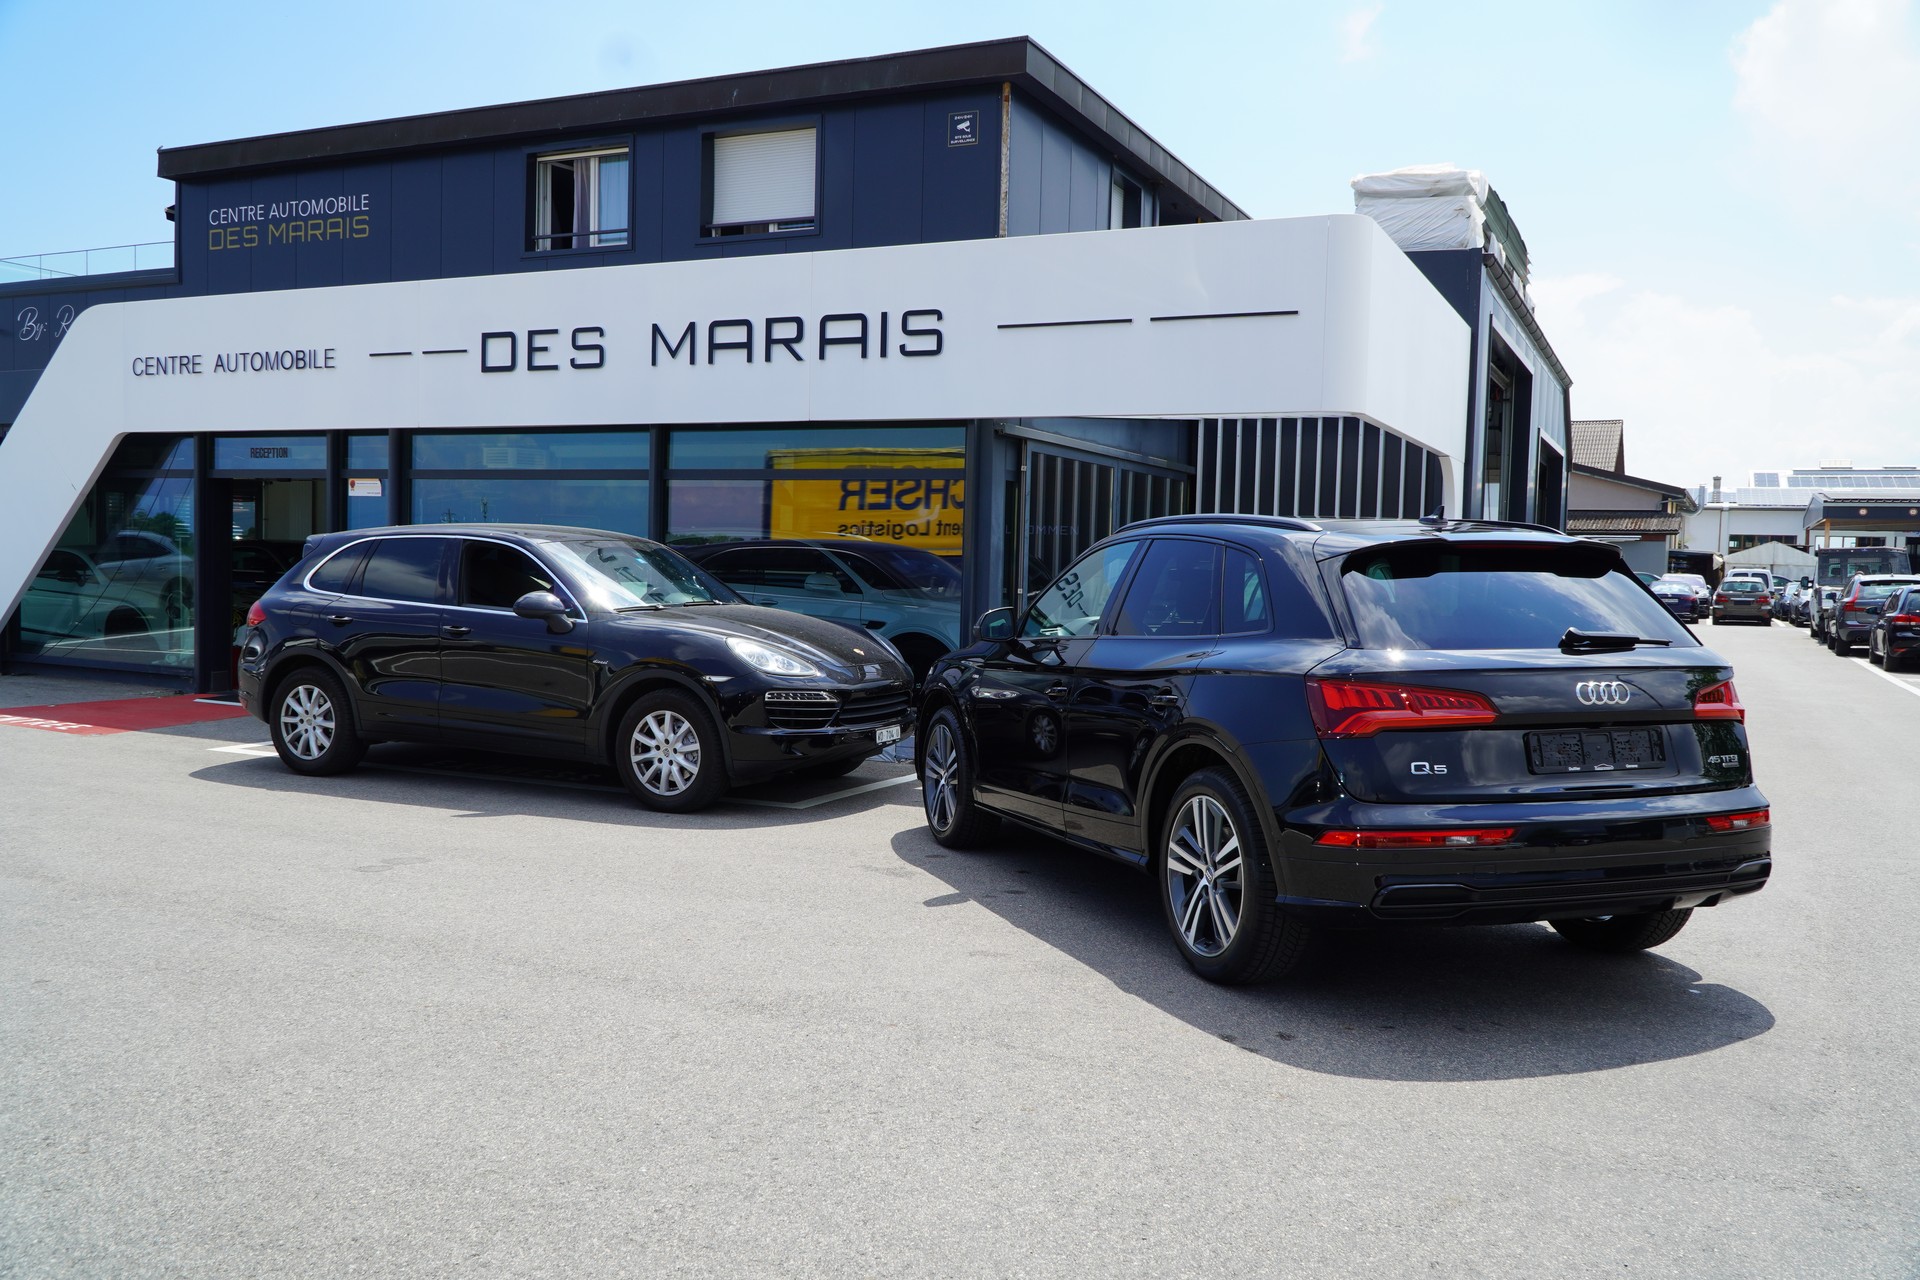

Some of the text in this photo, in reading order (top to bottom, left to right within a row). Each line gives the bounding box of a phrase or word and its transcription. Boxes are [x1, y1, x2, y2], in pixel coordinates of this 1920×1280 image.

[209, 194, 370, 226] CENTRE AUTOMOBILE
[209, 215, 370, 251] DES MARAIS
[131, 308, 944, 377] CENTRE AUTOMOBILE DES MARAIS
[250, 447, 288, 459] RECEPTION
[1410, 761, 1448, 775] Q5
[1707, 755, 1721, 763] 45
